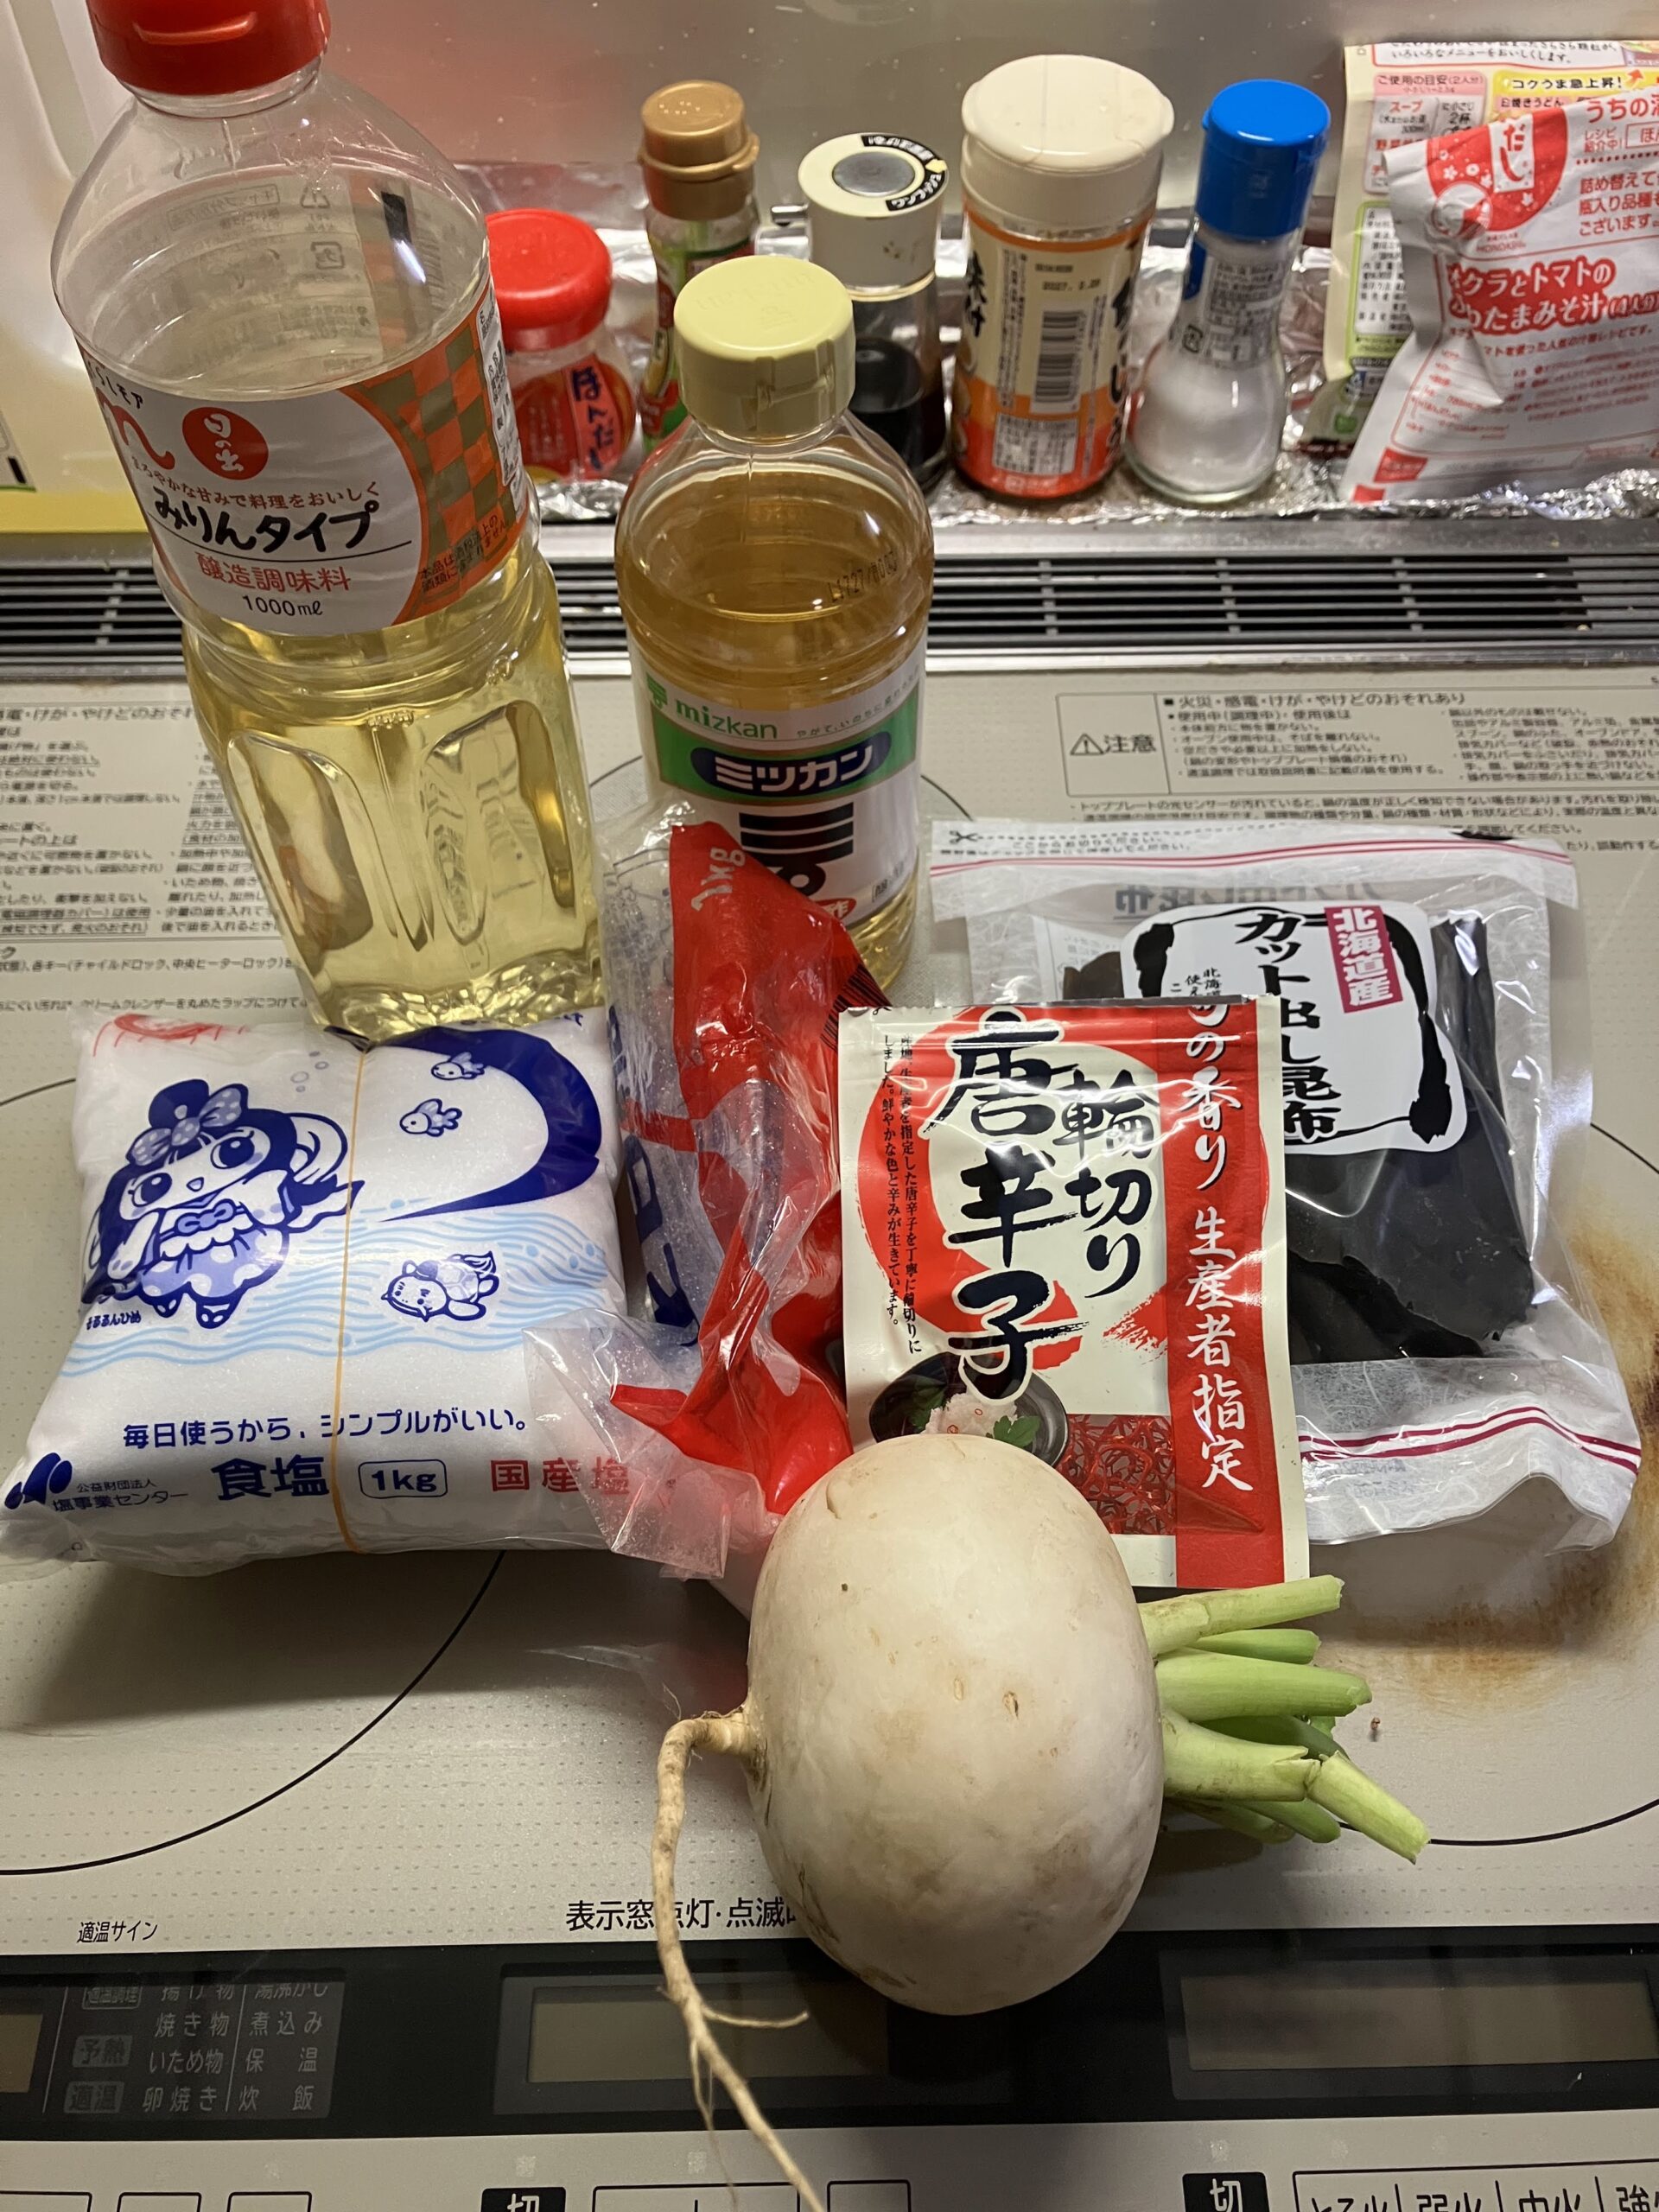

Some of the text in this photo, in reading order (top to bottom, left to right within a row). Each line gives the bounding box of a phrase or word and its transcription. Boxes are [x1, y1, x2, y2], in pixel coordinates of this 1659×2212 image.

[1512, 77, 1623, 90] コクうま急上昇!
[1389, 101, 1423, 113] スープ
[1500, 124, 1527, 181] だし
[1586, 129, 1618, 142] レシピ
[1580, 170, 1659, 195] 詰め替えて
[131, 454, 380, 510] まろやかな甘みで料理をおいしく
[154, 486, 380, 554] みりんタイプ
[194, 550, 352, 594] 醸造調味料
[676, 698, 778, 741] mizkan
[1104, 734, 1157, 754] 注意
[715, 745, 874, 793] ミツカン
[1333, 907, 1393, 1007] 北海道産
[1052, 1068, 1160, 1299] 輪切り
[924, 1010, 1091, 1402] 唐辛子
[1185, 1205, 1254, 1492] 生産者指定
[123, 1408, 527, 1449] 毎日使うから、シンプルがいい。
[76, 1478, 157, 1493] 公益財団法人
[210, 1454, 330, 1501] 食塩
[371, 1467, 438, 1495] 1kg
[491, 1456, 630, 1497] 国産塩
[52, 1491, 188, 1512] 塩事業センター
[77, 1921, 159, 1944] 適温サイン
[155, 2012, 229, 2037] 焼き物
[250, 2010, 324, 2036] 煮込み
[149, 2048, 224, 2074] いため物
[143, 2085, 218, 2113] 卵焼き
